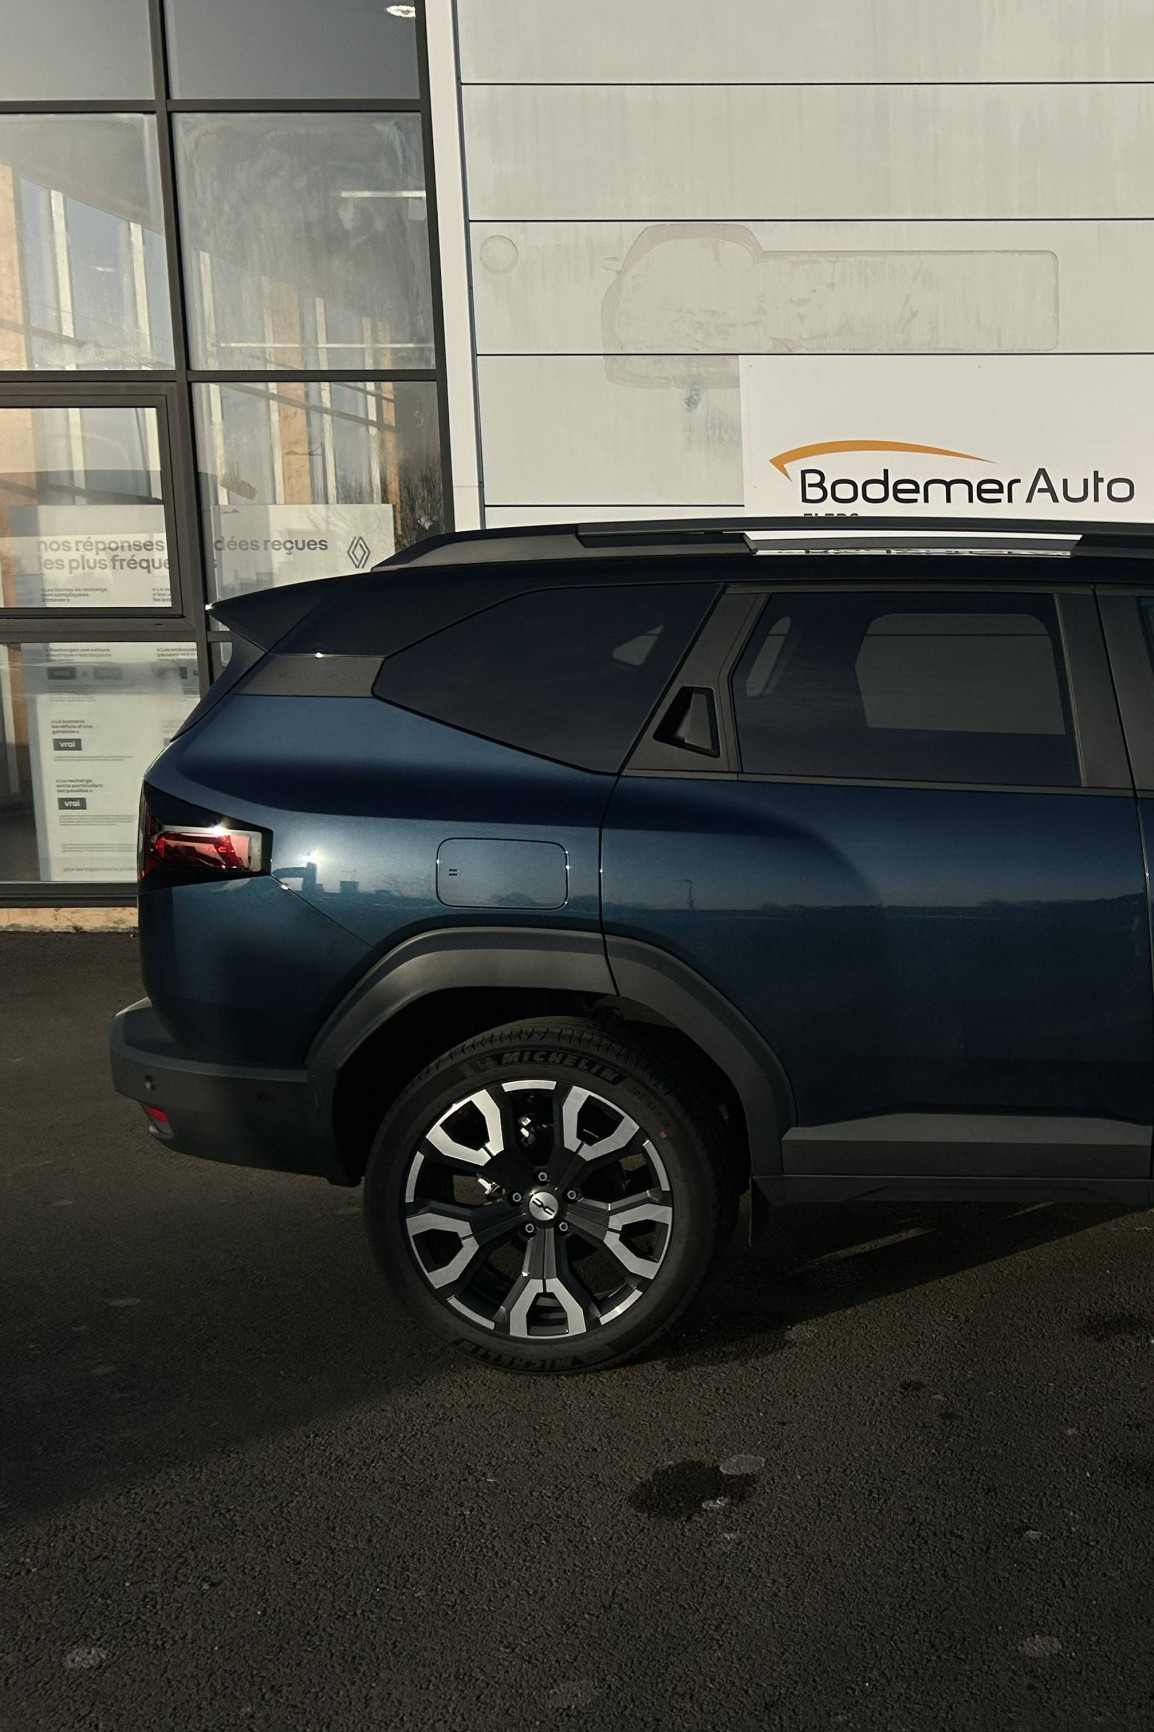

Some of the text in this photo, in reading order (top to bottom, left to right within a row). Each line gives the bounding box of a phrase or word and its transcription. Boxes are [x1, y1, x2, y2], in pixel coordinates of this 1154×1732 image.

[37, 536, 165, 555] nos réponses
[263, 539, 328, 555] reçues
[68, 554, 108, 574] plus
[501, 1050, 621, 1083] MICHELIN
